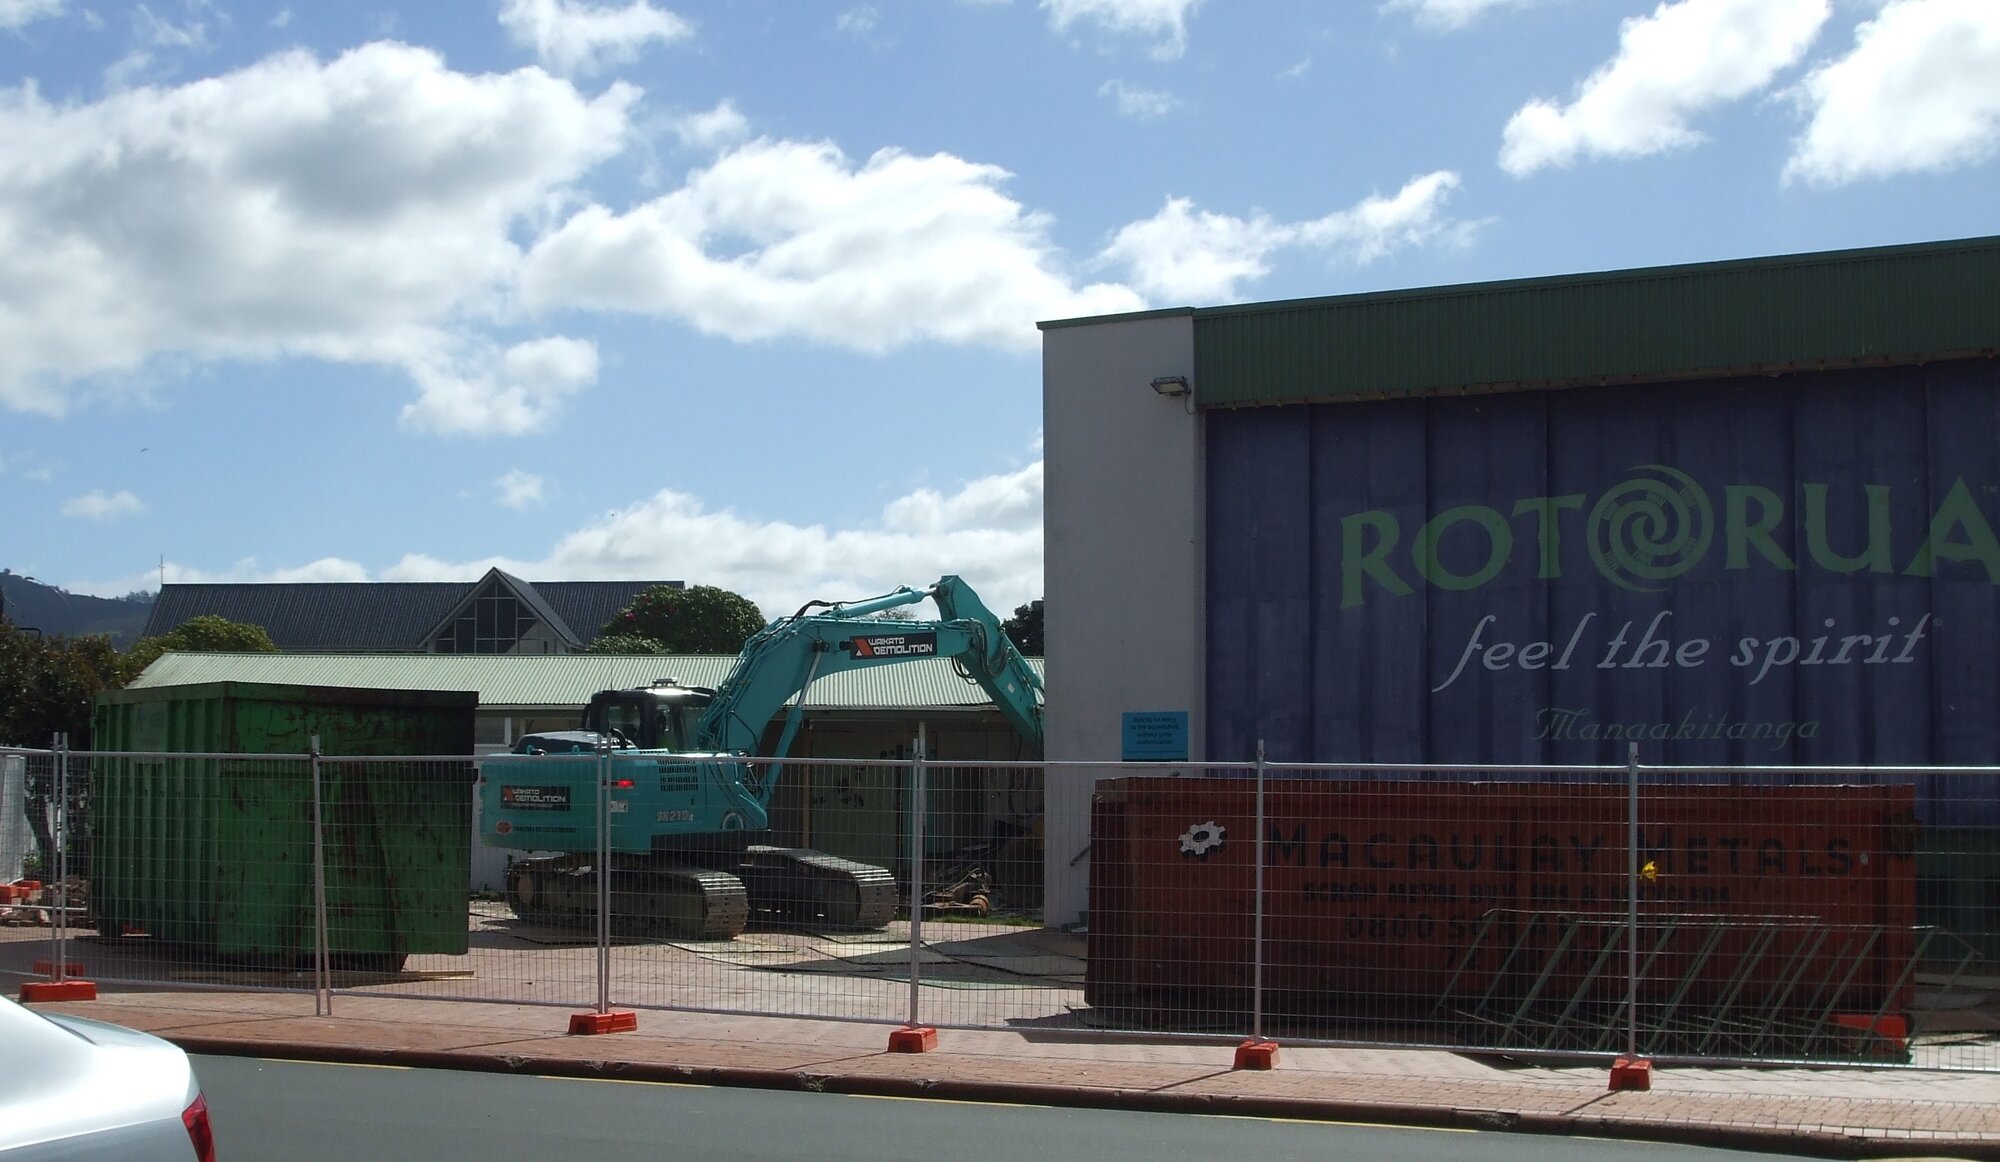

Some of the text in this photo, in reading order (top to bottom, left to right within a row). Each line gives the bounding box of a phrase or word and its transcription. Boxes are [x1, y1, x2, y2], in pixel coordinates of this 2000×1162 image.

[1339, 464, 2000, 610] ROTORUA
[868, 637, 905, 646] WAIKATO
[873, 643, 933, 655] DEMOLITION
[1432, 610, 1934, 693] feel the spirit
[515, 795, 566, 803] DEMOLITION
[1268, 823, 1853, 876] MACAULAY METALS
[1345, 912, 1435, 939] 0800
